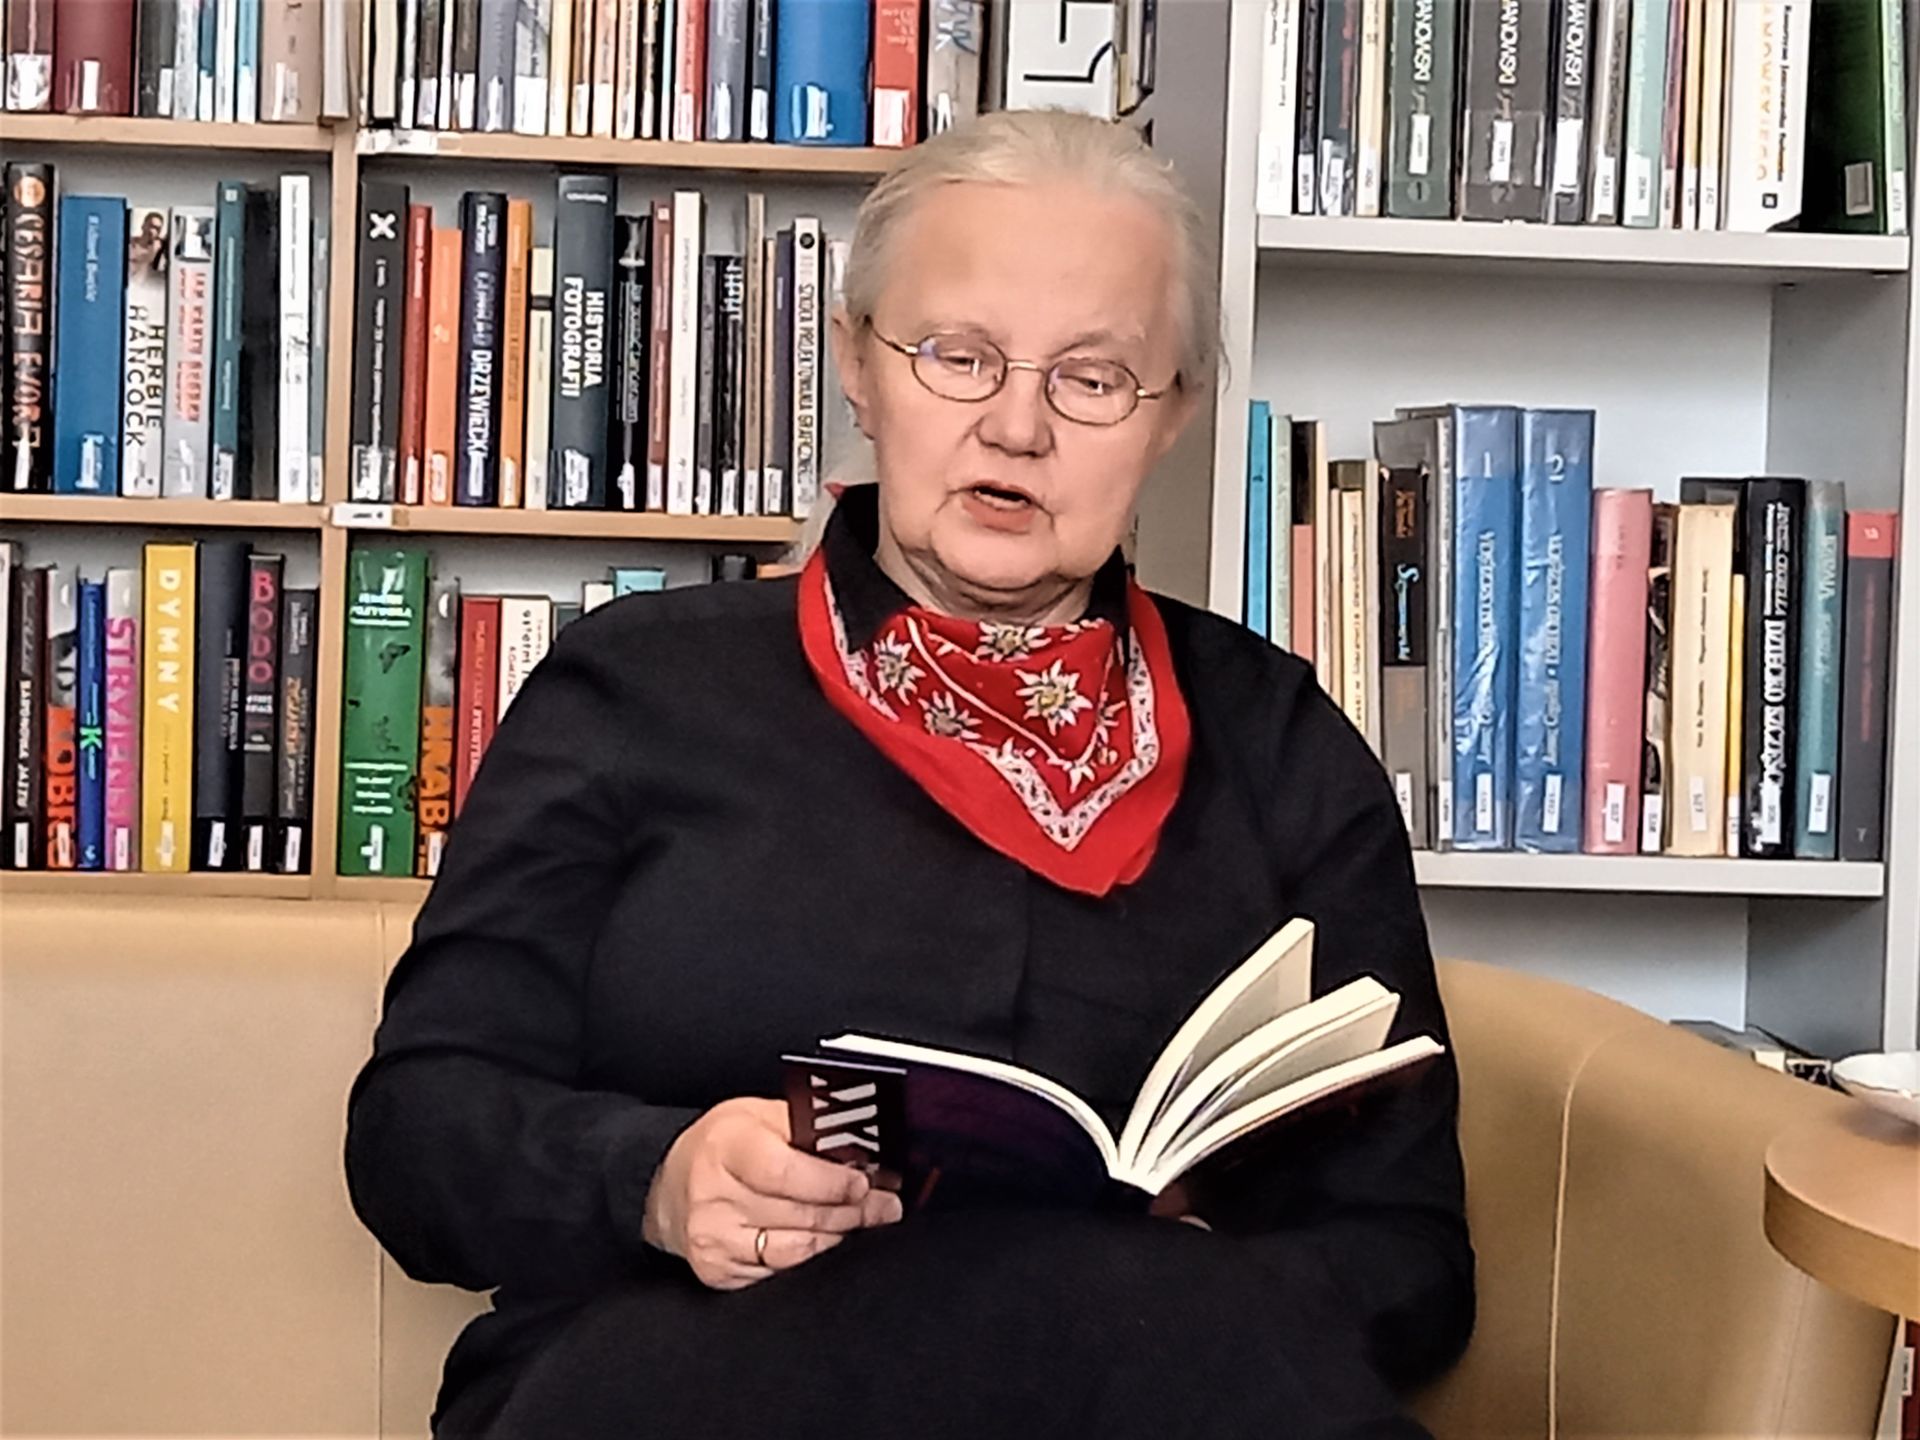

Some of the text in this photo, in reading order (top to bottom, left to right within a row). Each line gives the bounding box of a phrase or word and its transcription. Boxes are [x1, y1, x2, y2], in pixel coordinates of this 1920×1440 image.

[14, 212, 43, 335] CESARIA
[126, 305, 149, 447] HANCOCK
[148, 325, 166, 429] HERBIE
[561, 276, 585, 398] FOTOGRAFII
[583, 290, 604, 388] HISTORIA
[1549, 454, 1565, 481] 2
[156, 568, 182, 714] DYMNY
[249, 570, 275, 683] BODO
